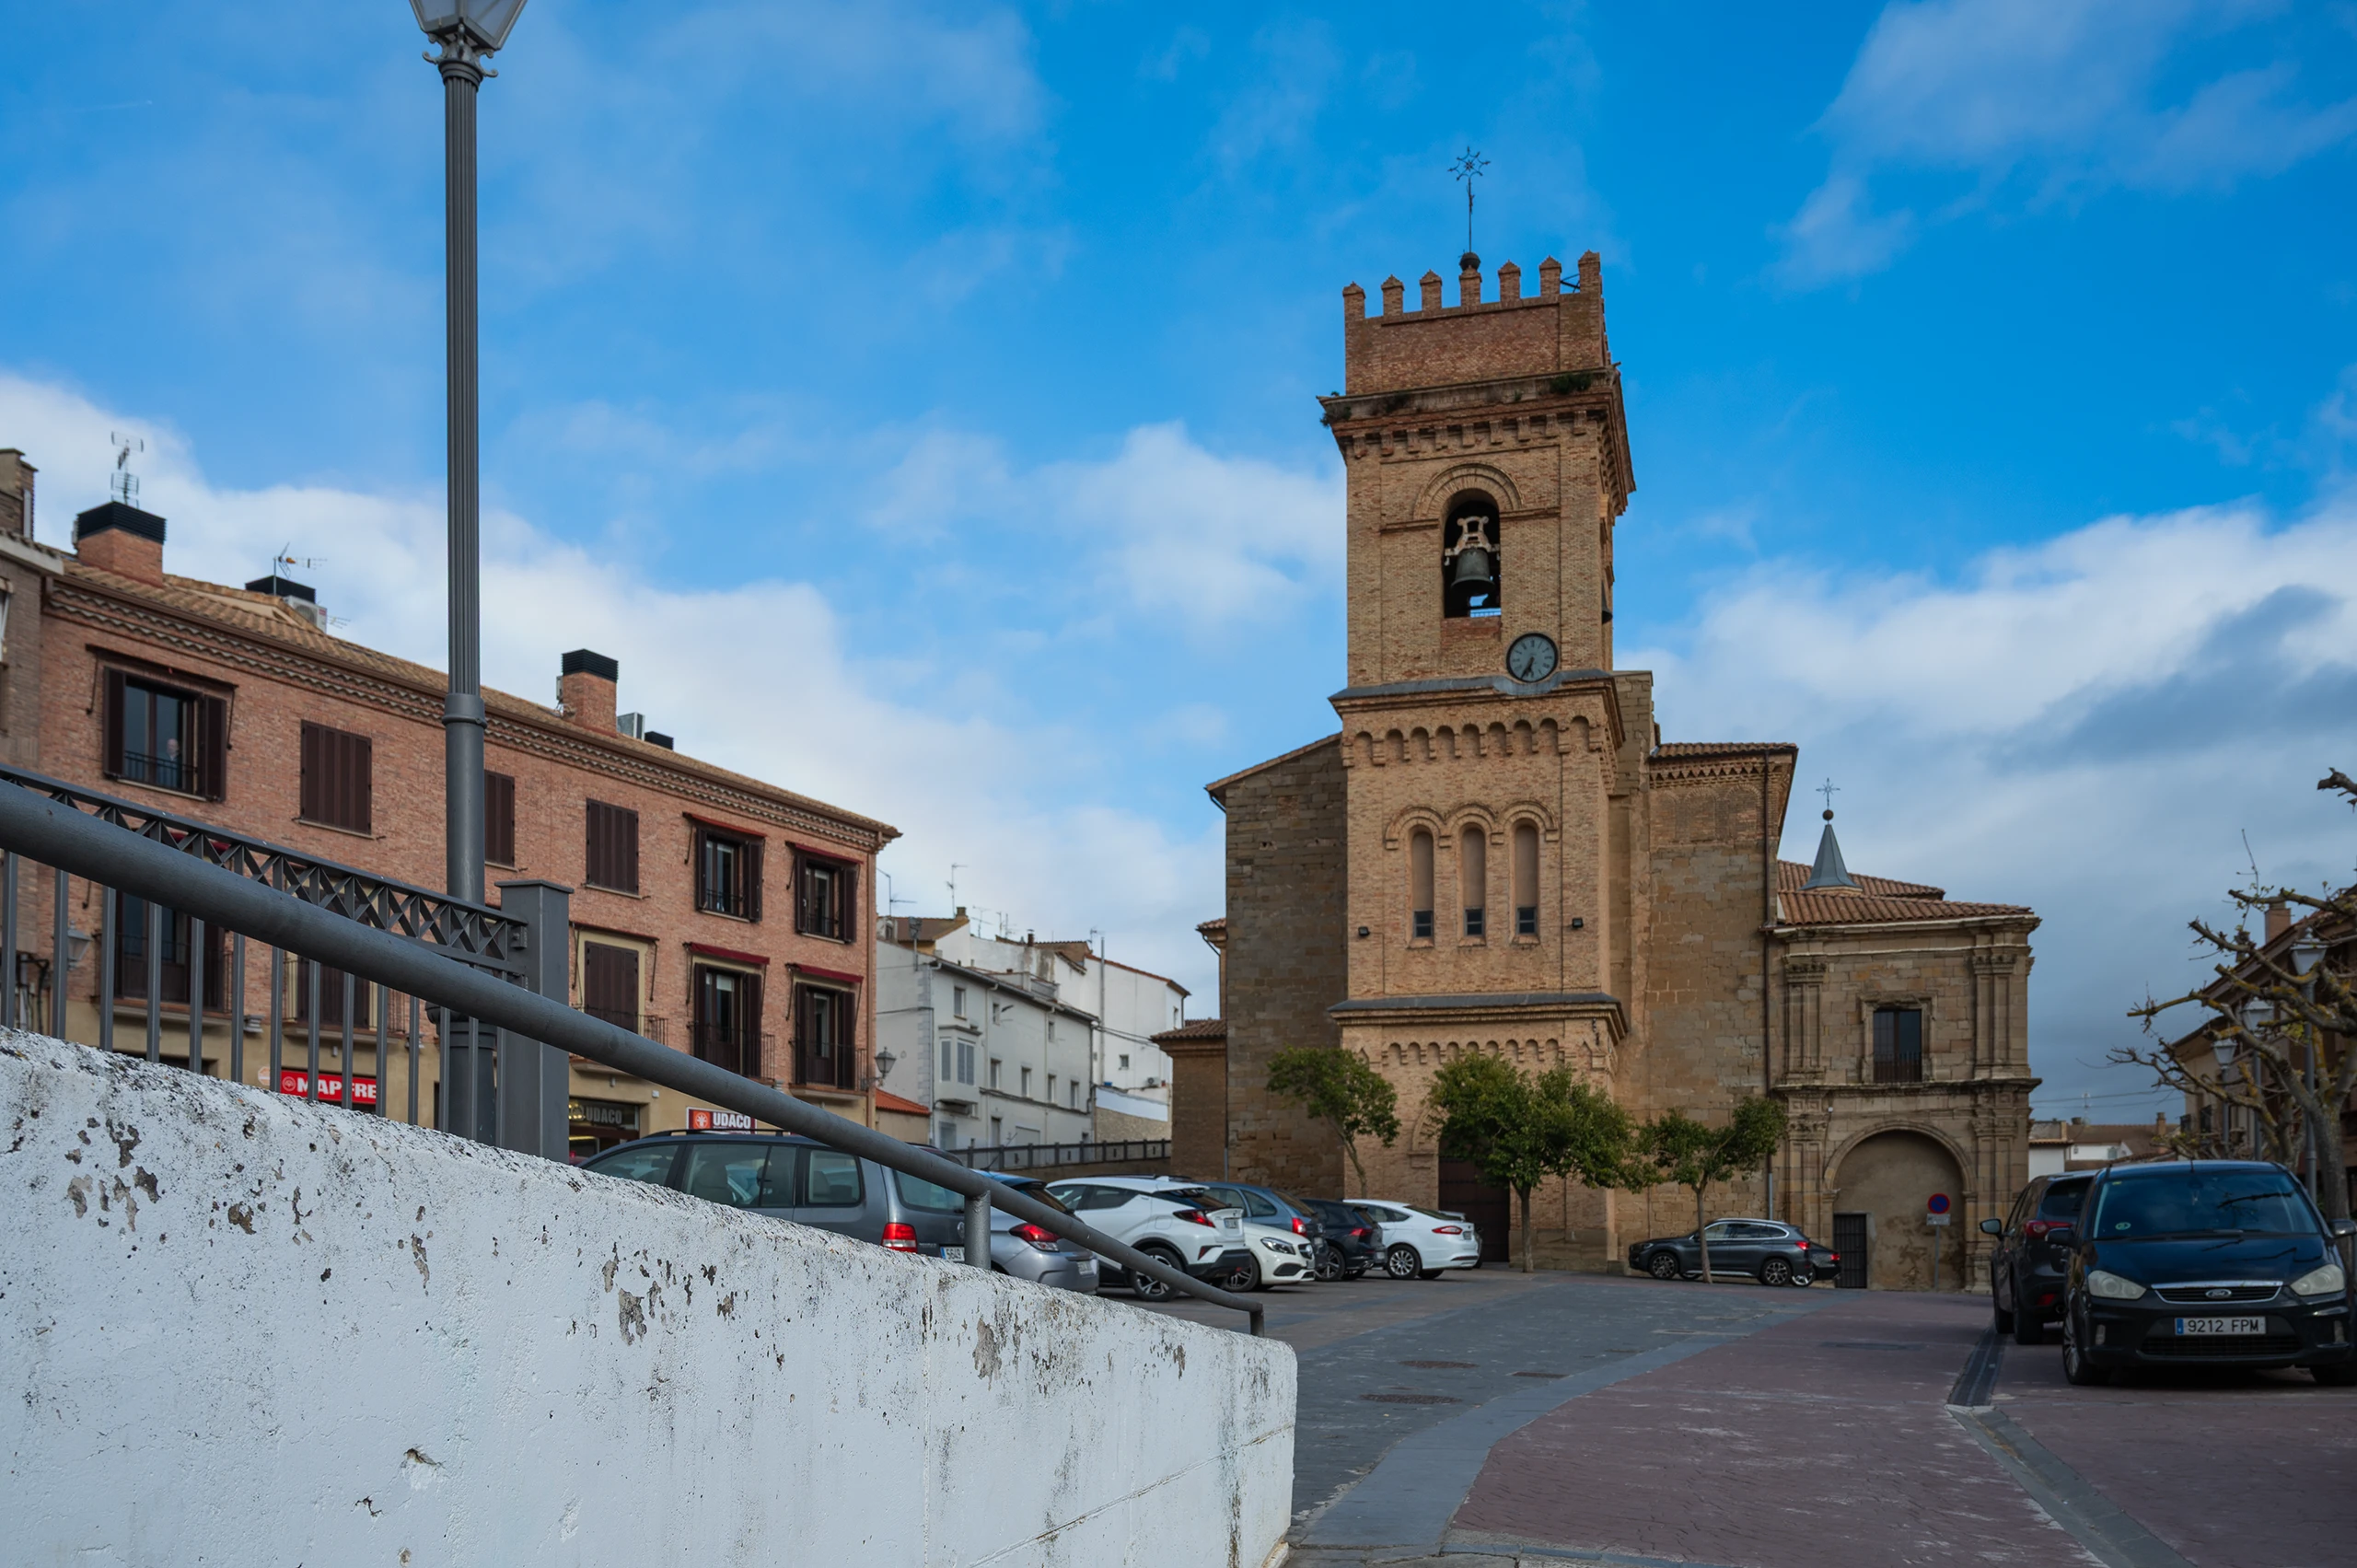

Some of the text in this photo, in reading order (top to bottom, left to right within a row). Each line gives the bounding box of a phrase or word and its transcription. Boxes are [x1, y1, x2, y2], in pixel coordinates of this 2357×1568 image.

[586, 1106, 622, 1124] UDACO
[713, 1112, 751, 1129] UDACO
[2188, 1318, 2258, 1332] 9212 FPM
